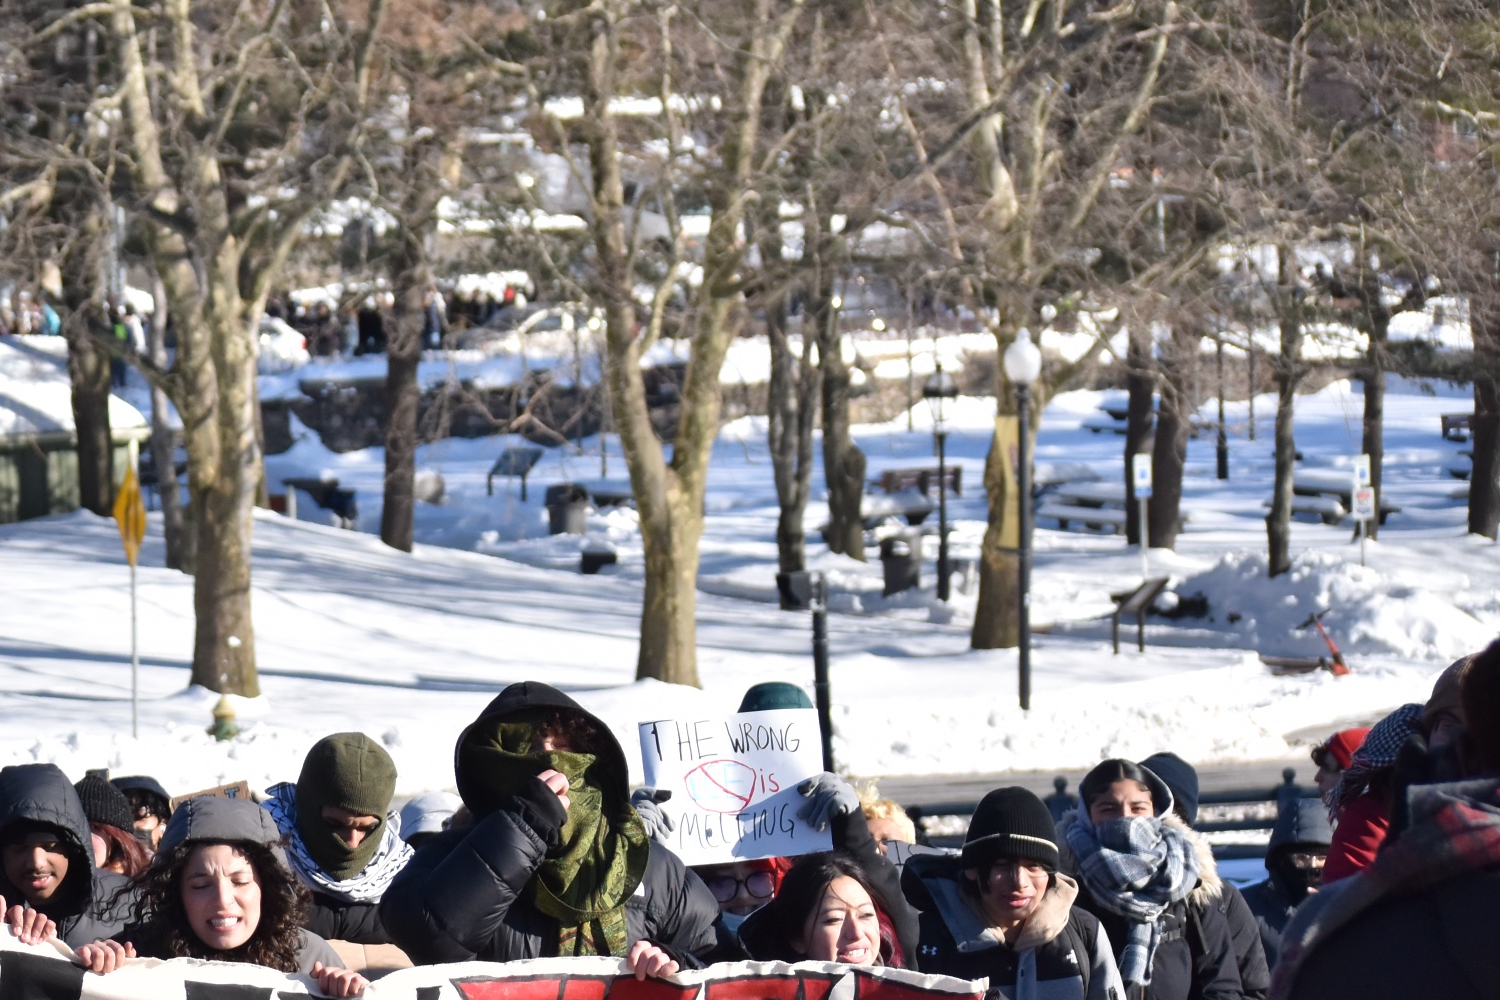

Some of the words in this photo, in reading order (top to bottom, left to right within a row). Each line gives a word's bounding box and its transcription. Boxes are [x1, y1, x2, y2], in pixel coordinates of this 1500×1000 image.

[641, 719, 718, 761] THE
[725, 721, 800, 754] WRONG
[760, 768, 780, 794] is
